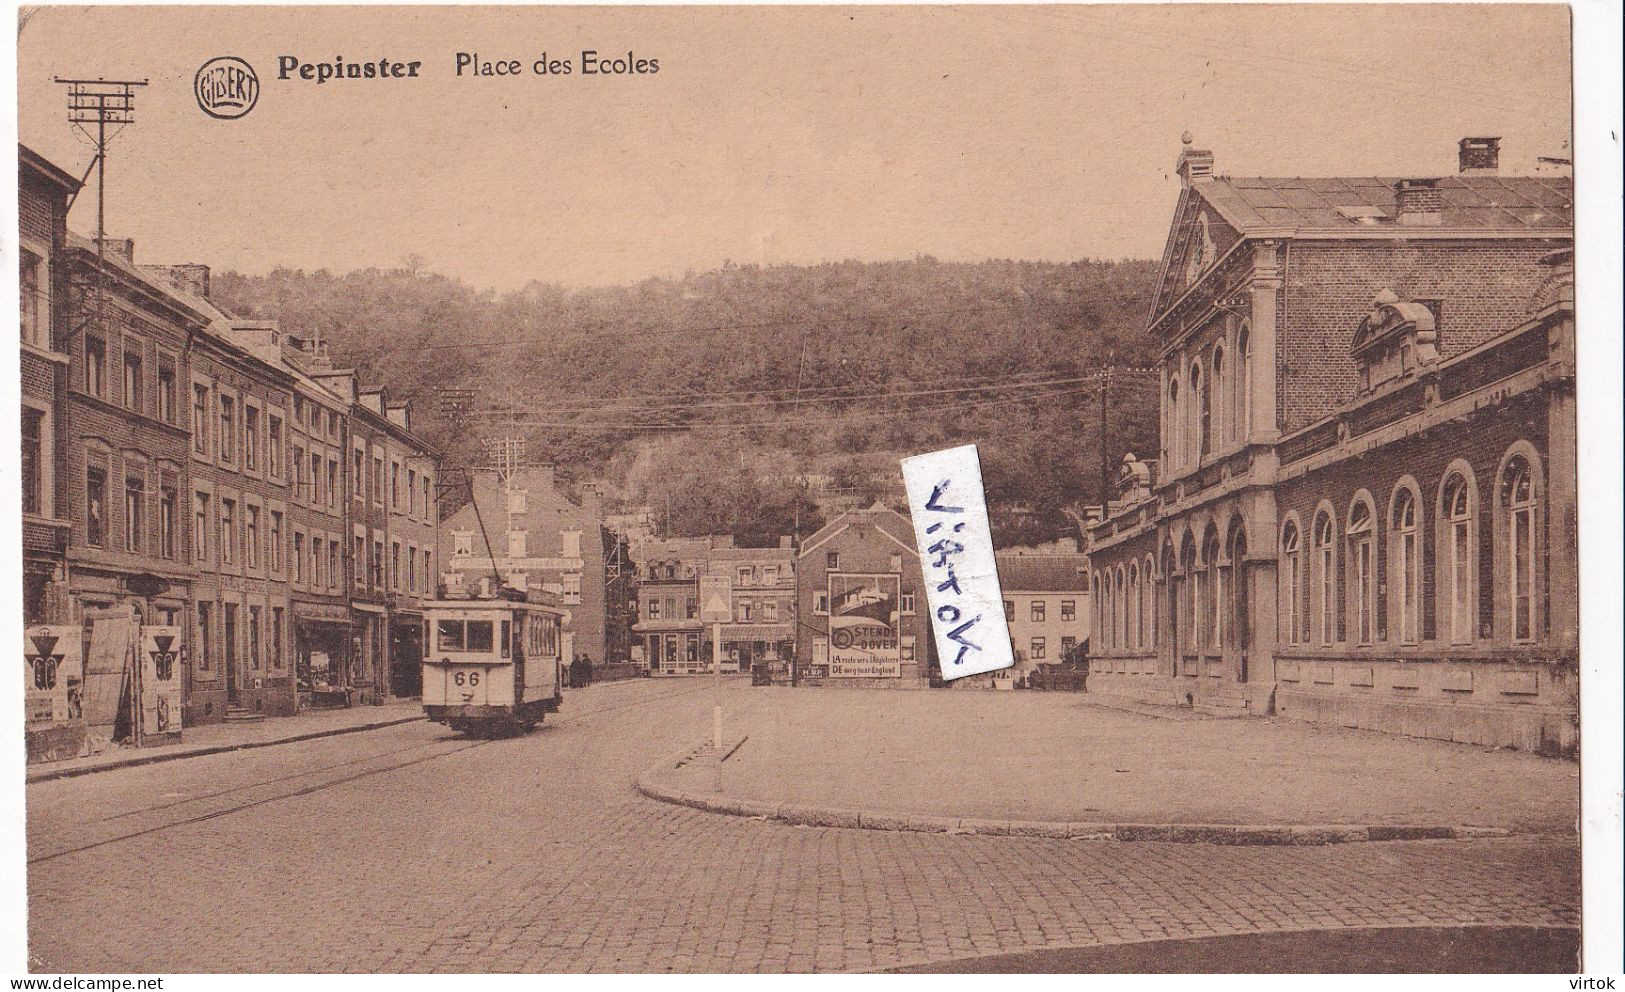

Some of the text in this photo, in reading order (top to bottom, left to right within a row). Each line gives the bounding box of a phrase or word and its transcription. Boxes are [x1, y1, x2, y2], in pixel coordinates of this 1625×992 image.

[861, 640, 898, 650] DOVER
[832, 655, 841, 664] LA
[832, 665, 843, 674] DE
[454, 671, 480, 687] 66
